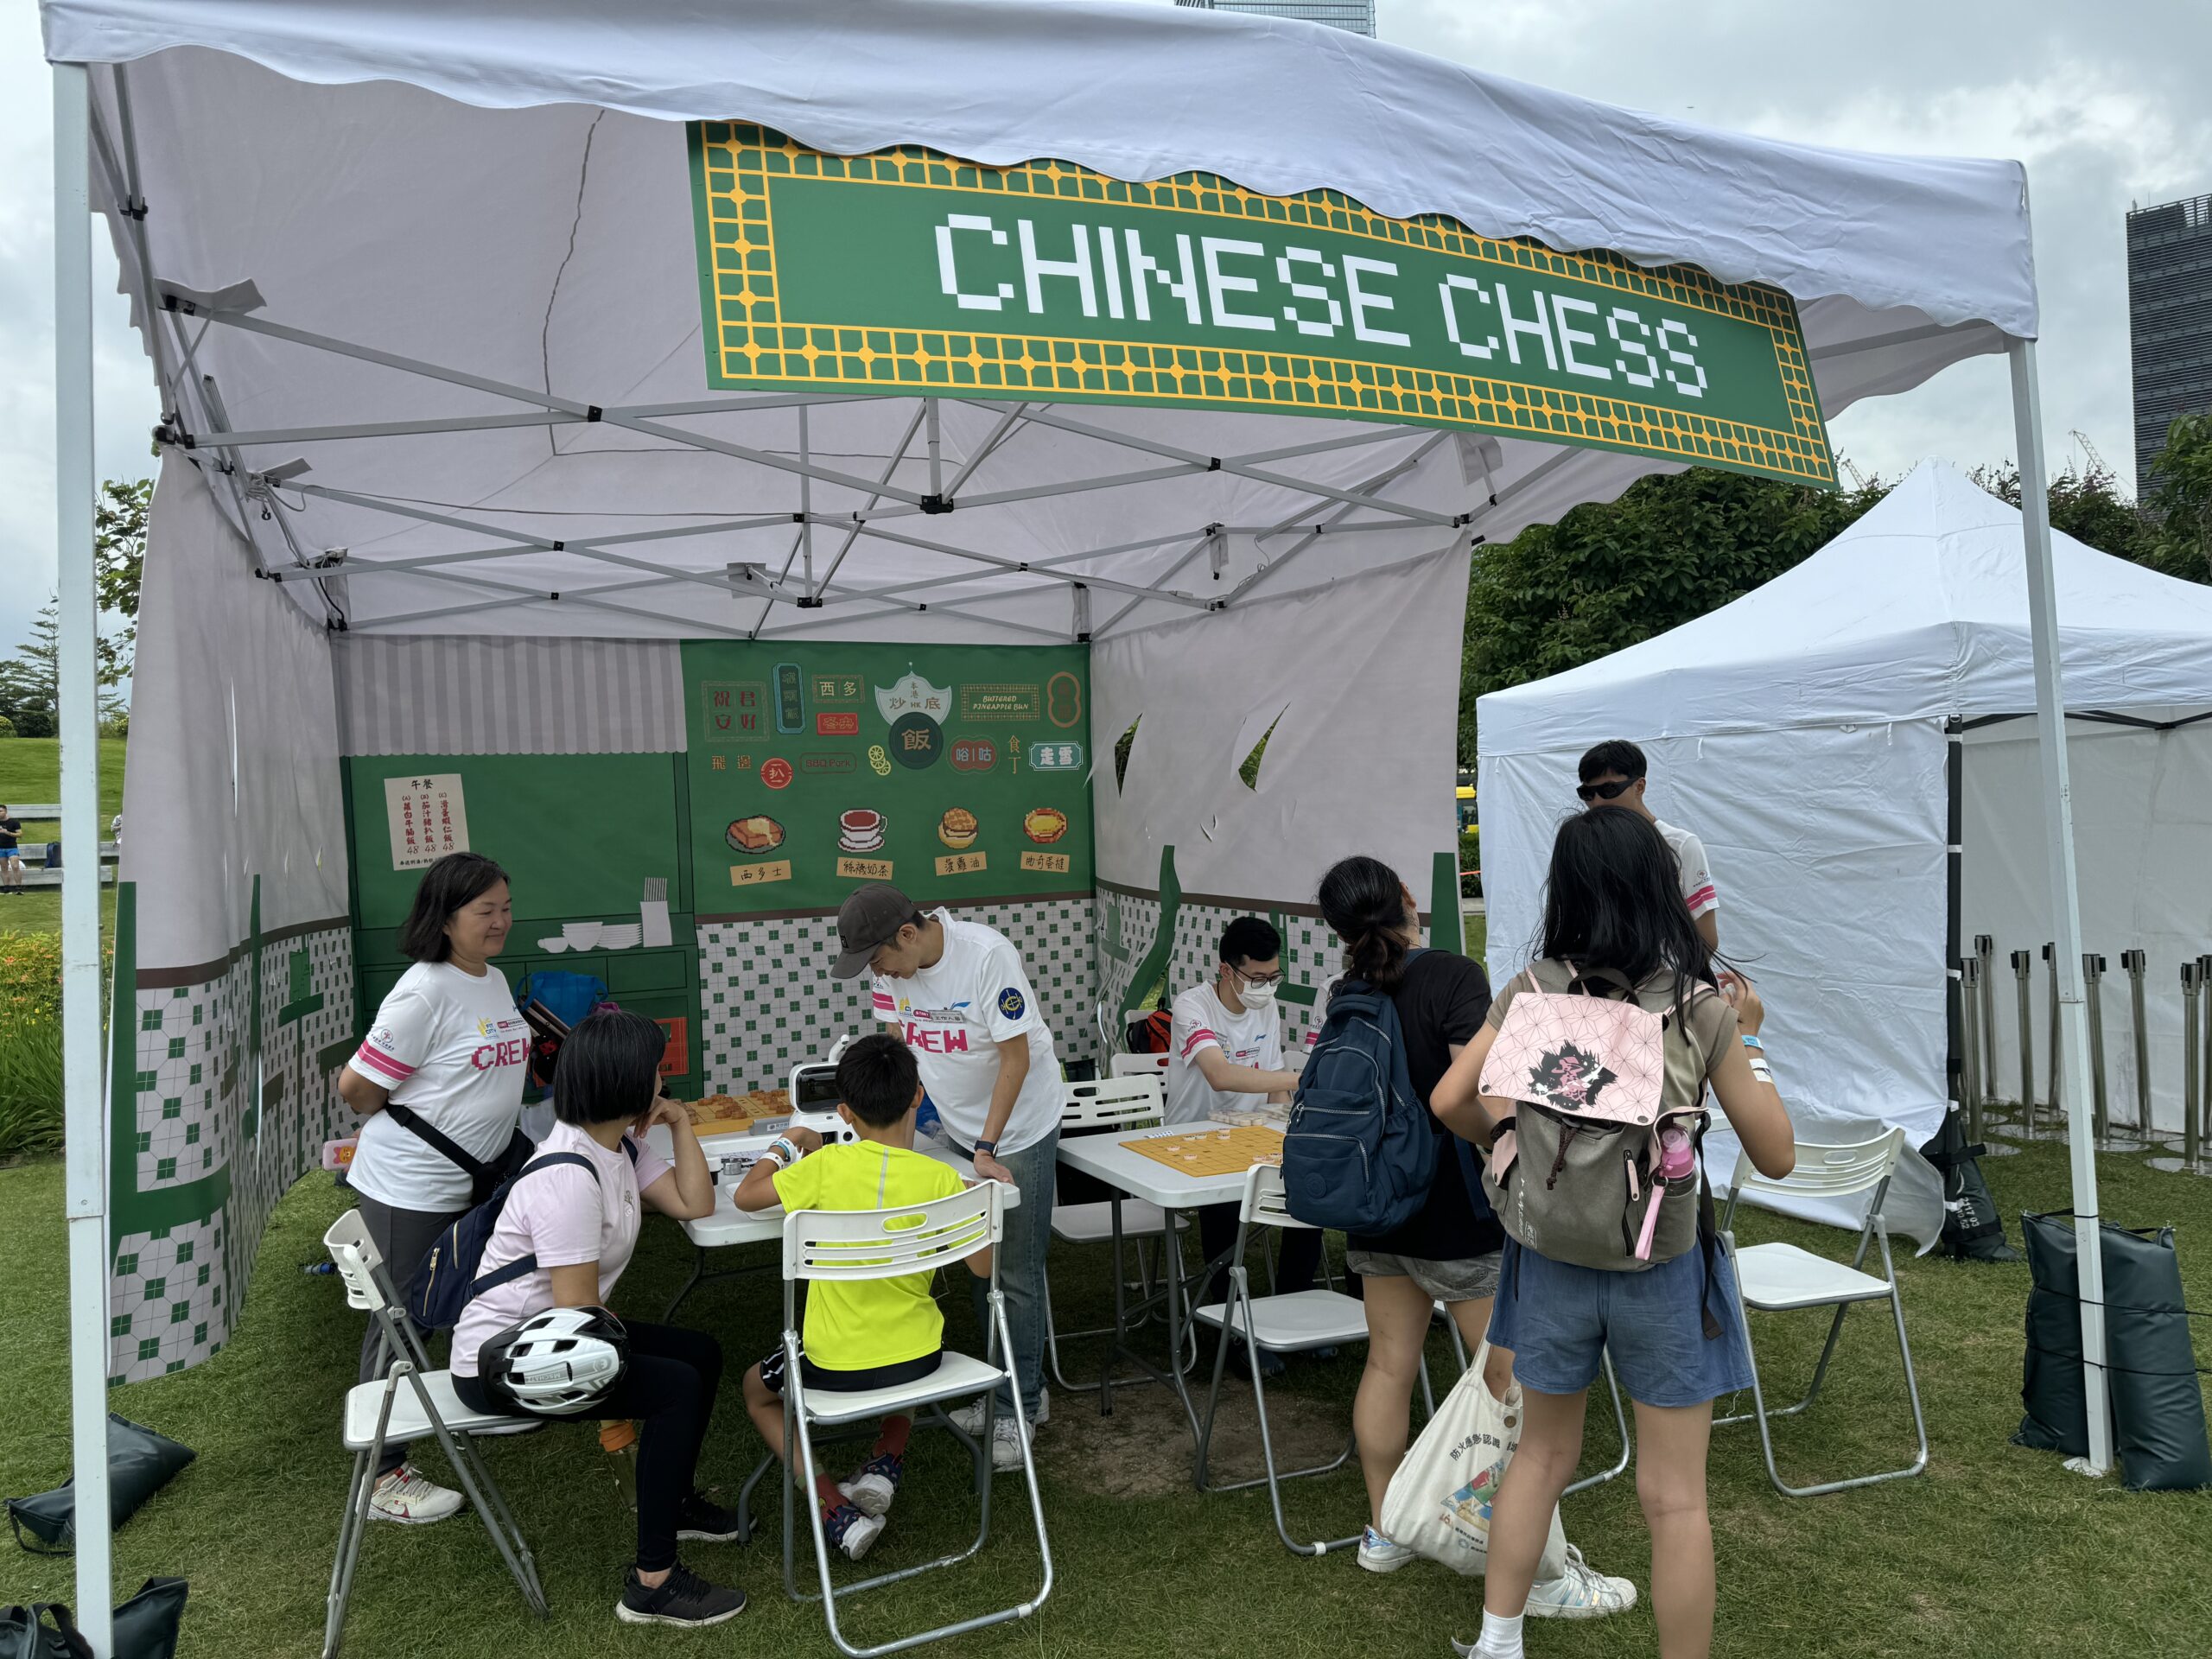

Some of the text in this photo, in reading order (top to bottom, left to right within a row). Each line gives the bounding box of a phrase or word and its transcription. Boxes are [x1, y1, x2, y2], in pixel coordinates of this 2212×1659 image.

[934, 213, 1709, 399] CHINESE CHESS
[819, 681, 856, 696] 西多
[901, 728, 931, 750] 飯
[411, 779, 434, 791] 午餐
[407, 846, 419, 855] 48
[425, 844, 437, 854] 48
[442, 842, 454, 851] 48
[741, 867, 782, 880] 西多士
[899, 1019, 968, 1053] REW
